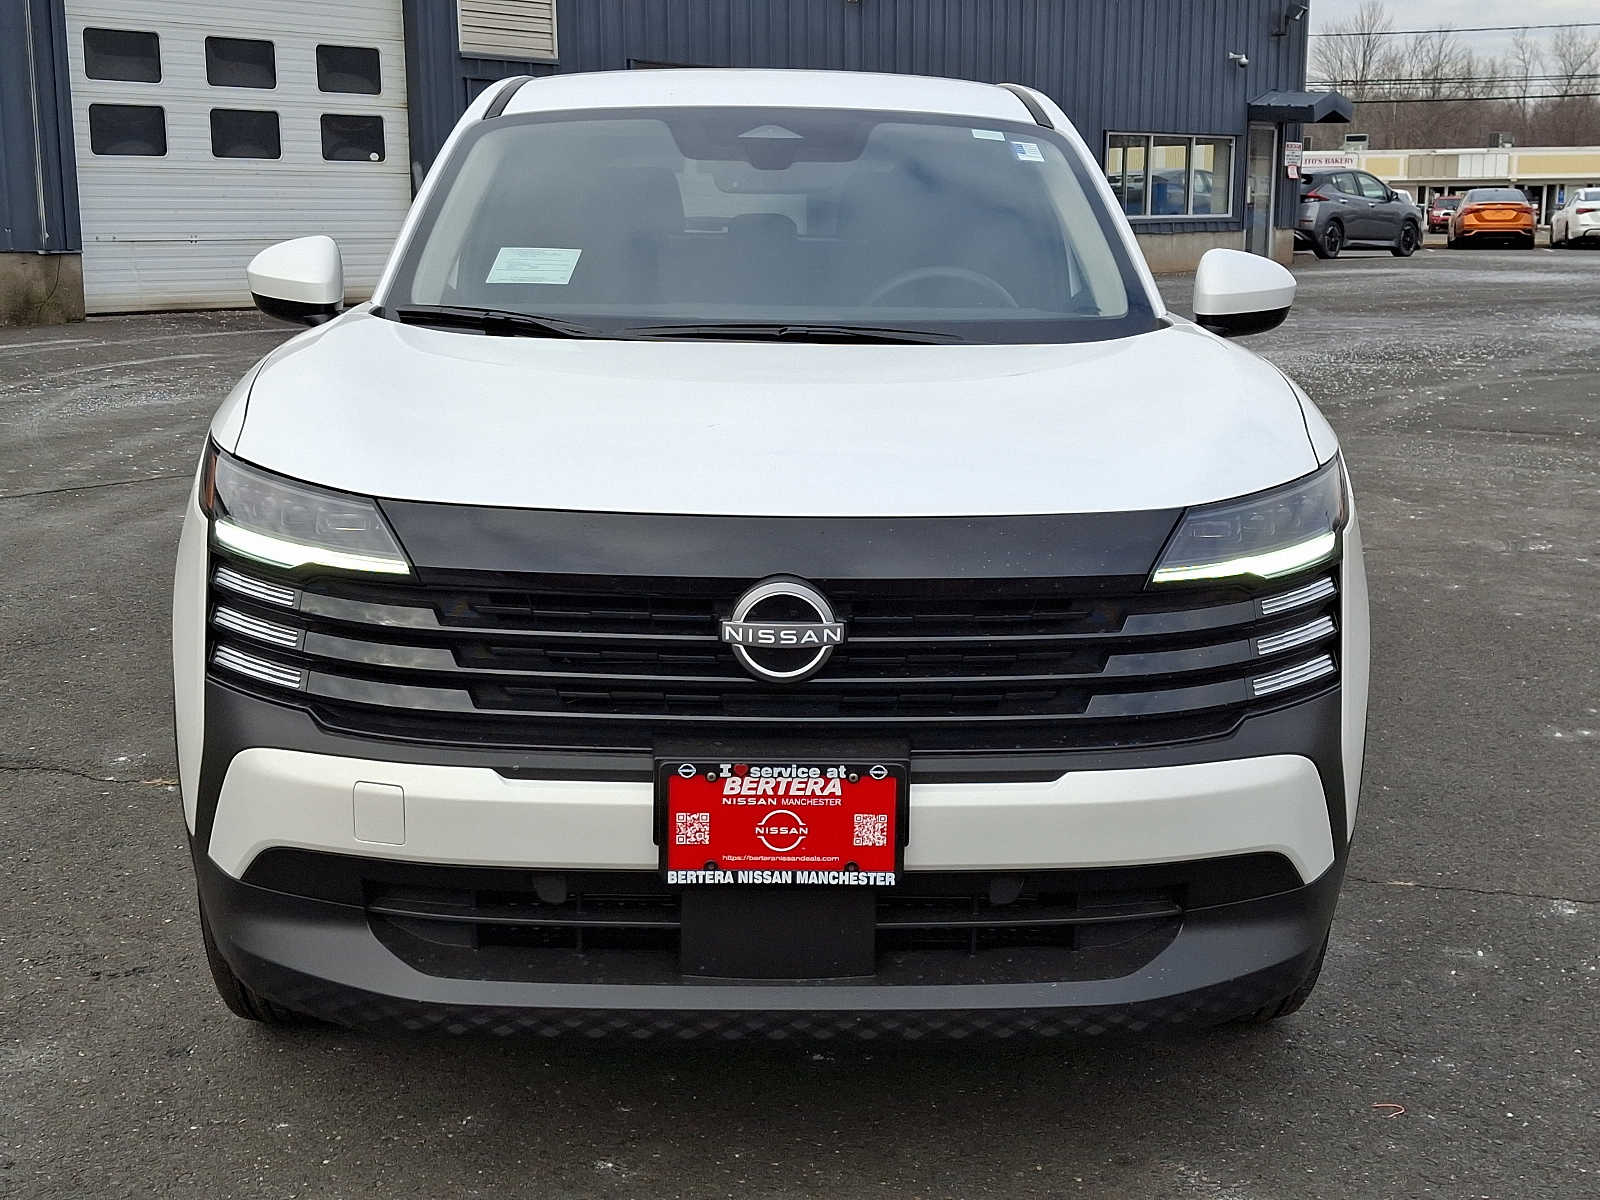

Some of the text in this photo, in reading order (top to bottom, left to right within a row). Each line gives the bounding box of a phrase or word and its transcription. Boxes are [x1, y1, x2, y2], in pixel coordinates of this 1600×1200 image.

[1325, 157, 1354, 165] BAKERY
[725, 626, 841, 644] NISSAN
[719, 763, 847, 779] I service at
[722, 777, 842, 796] BERTERA
[722, 797, 842, 806] NISSAN MANCHESTER
[755, 826, 809, 835] NISSAN
[667, 870, 896, 886] BERTERA NISSAN MANCHESTER
